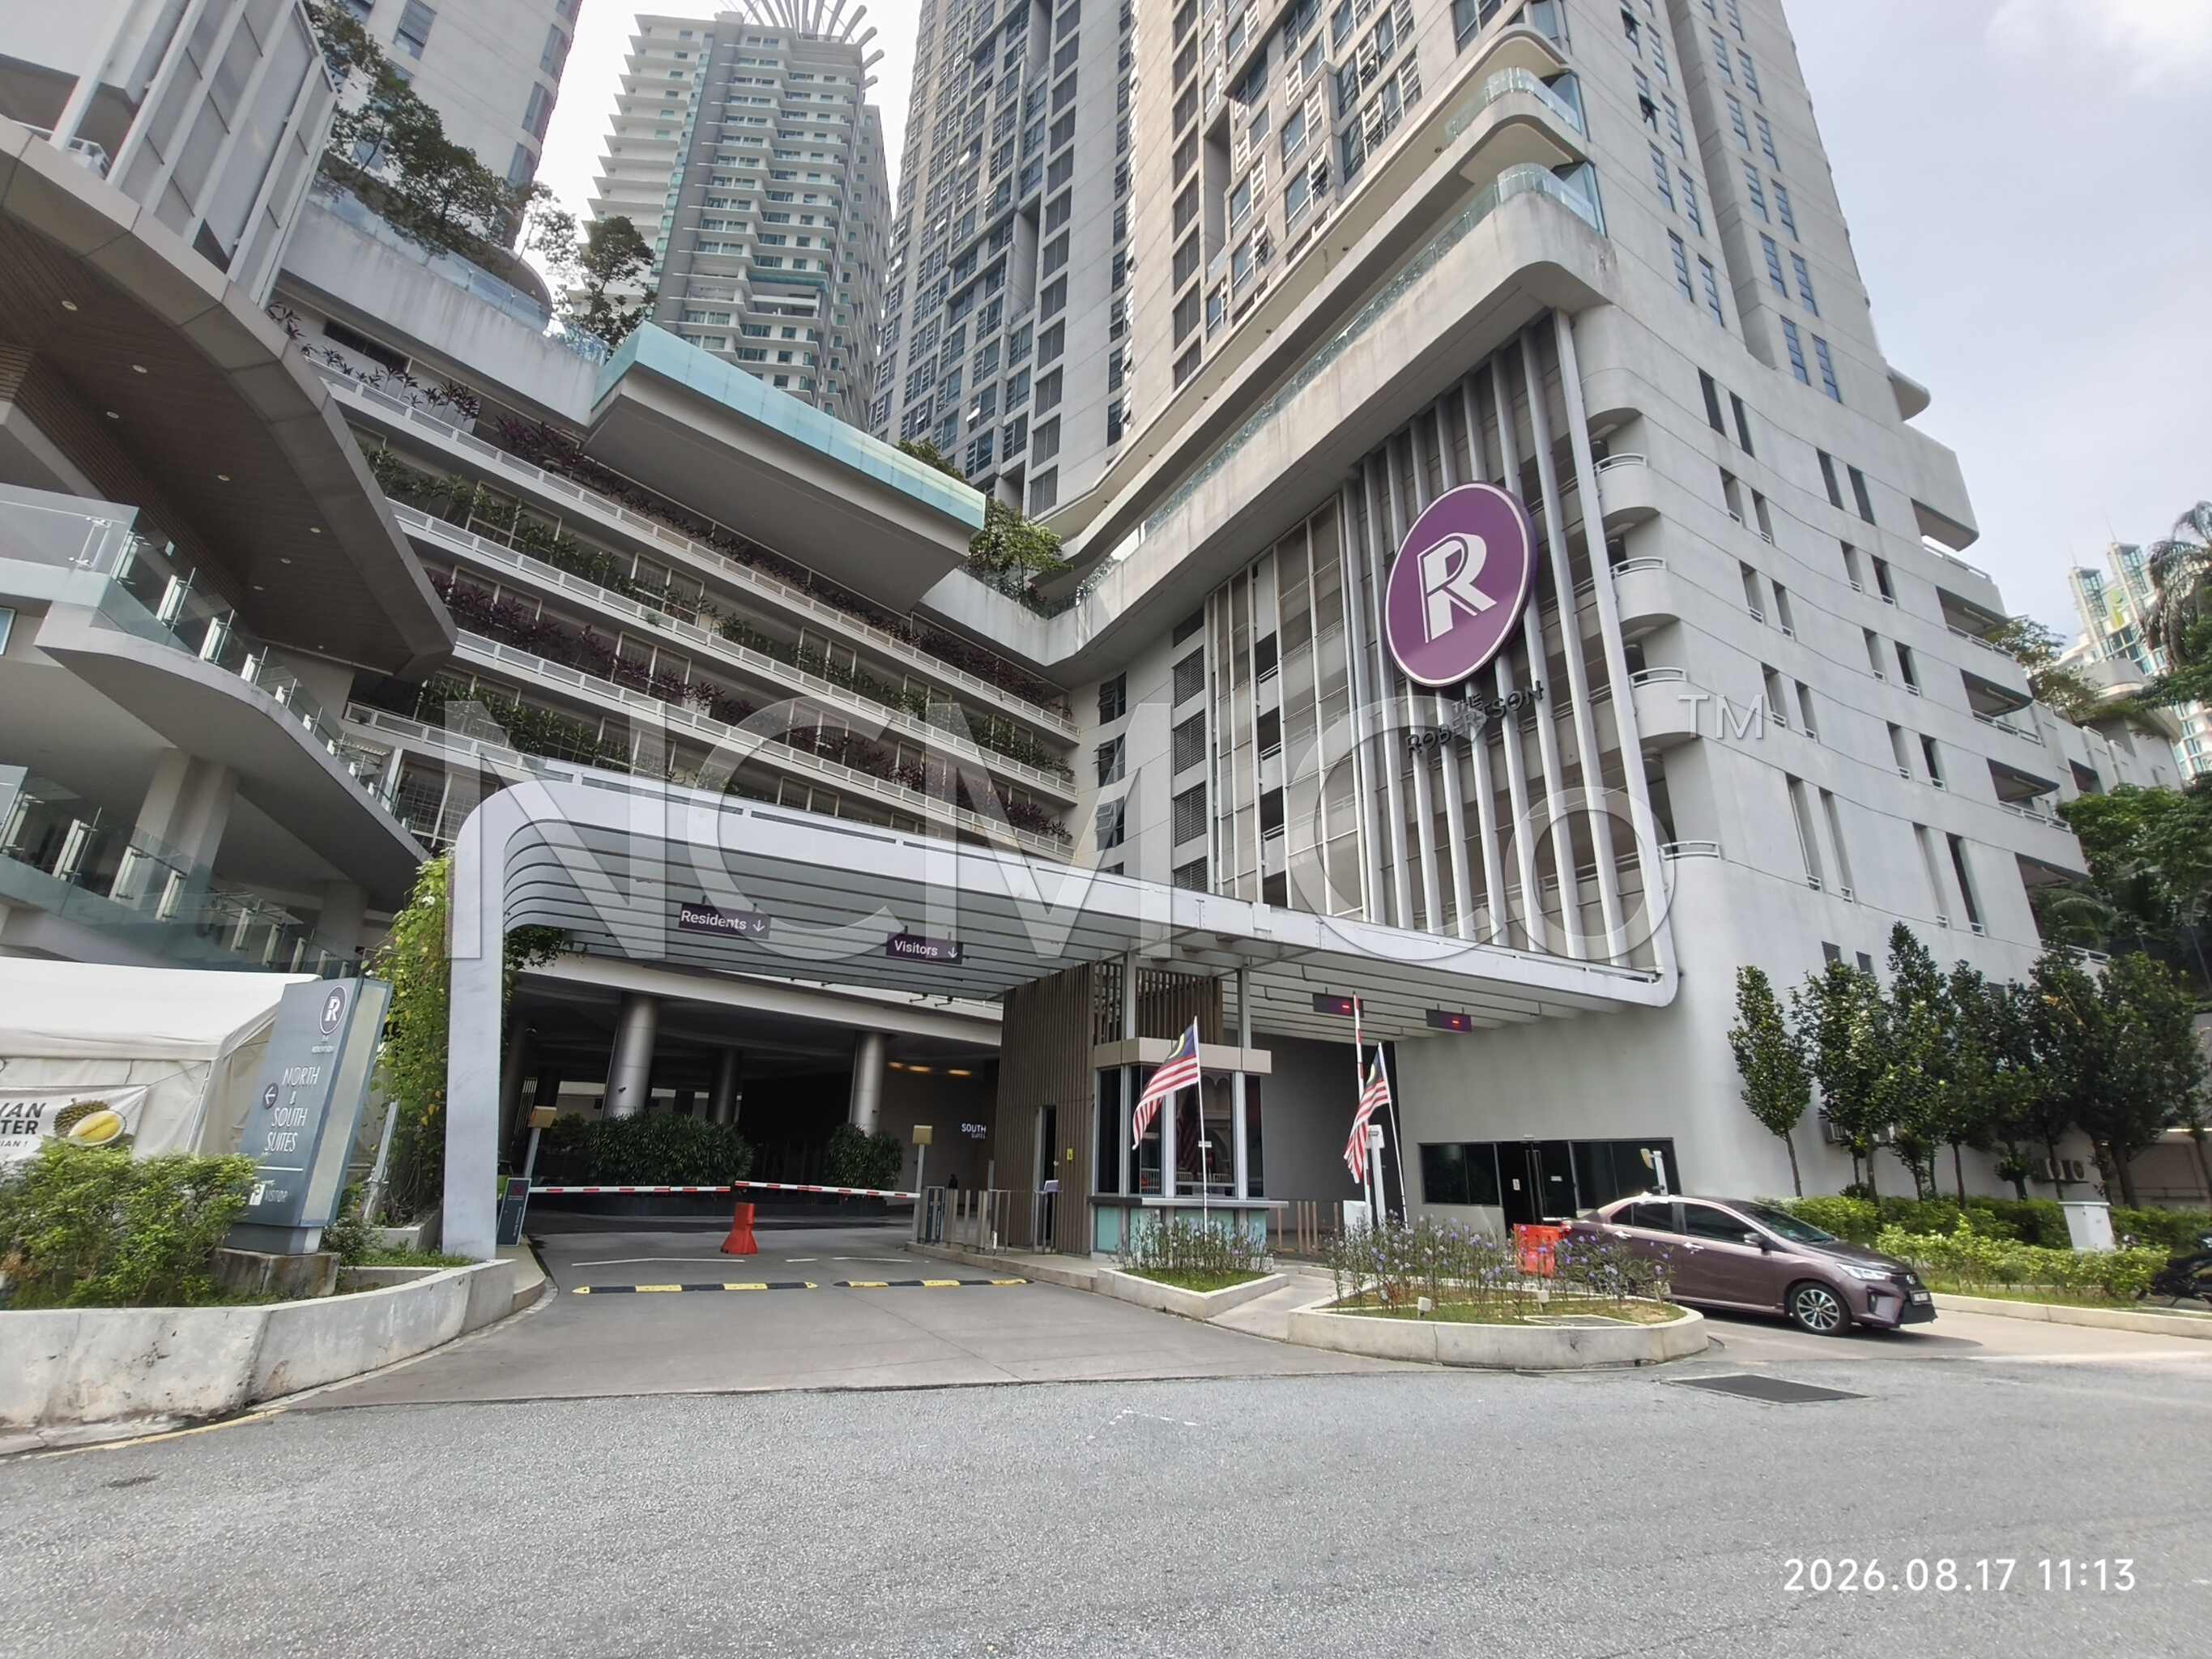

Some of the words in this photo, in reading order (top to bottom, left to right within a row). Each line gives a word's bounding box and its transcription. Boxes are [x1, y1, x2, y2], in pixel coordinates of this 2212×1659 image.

[1416, 531, 1498, 644] R
[1451, 693, 1483, 714] THE
[1405, 680, 1545, 758] ROBERTSON
[680, 910, 747, 931] Residents
[894, 940, 938, 957] Visitors
[325, 996, 340, 1021] R
[282, 1066, 321, 1085] NORTH
[271, 1107, 309, 1127] SOUTH
[1, 1120, 39, 1135] TER
[961, 1123, 987, 1133] SOUTH
[264, 1132, 298, 1152] SUITES
